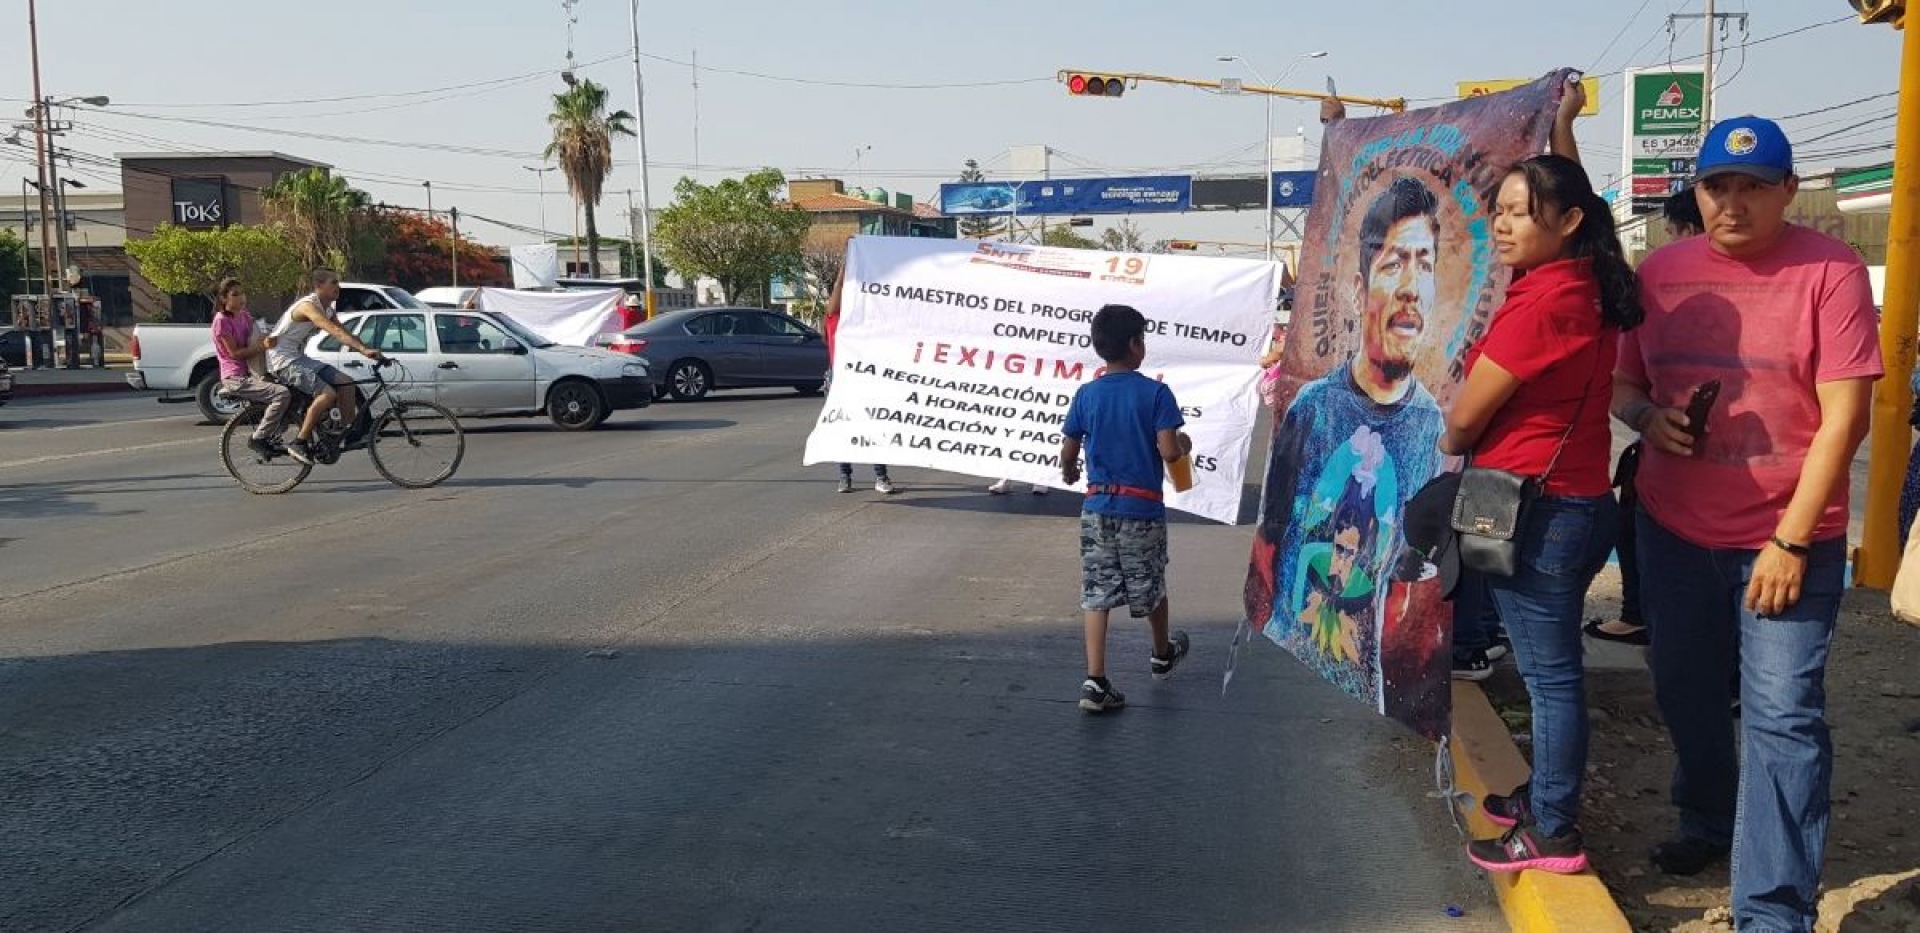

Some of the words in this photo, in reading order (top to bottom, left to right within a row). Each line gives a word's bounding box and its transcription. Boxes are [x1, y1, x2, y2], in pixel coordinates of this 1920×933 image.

[1642, 107, 1700, 120] PEMEX
[1104, 255, 1144, 275] 19
[861, 281, 890, 297] LOS
[895, 285, 989, 310] MAESTROS
[993, 299, 1025, 314] DEL
[1145, 319, 1168, 335] DE
[1174, 322, 1247, 347] TIEMPO
[1313, 271, 1331, 358] QUIEN
[882, 367, 1050, 405] REGULARIZACIÓN
[906, 391, 919, 404] A
[925, 394, 1016, 418] HORARIO
[890, 433, 903, 447] A
[909, 435, 932, 451] LA
[937, 439, 1003, 458] CARTA
[1004, 428, 1016, 438] Y
